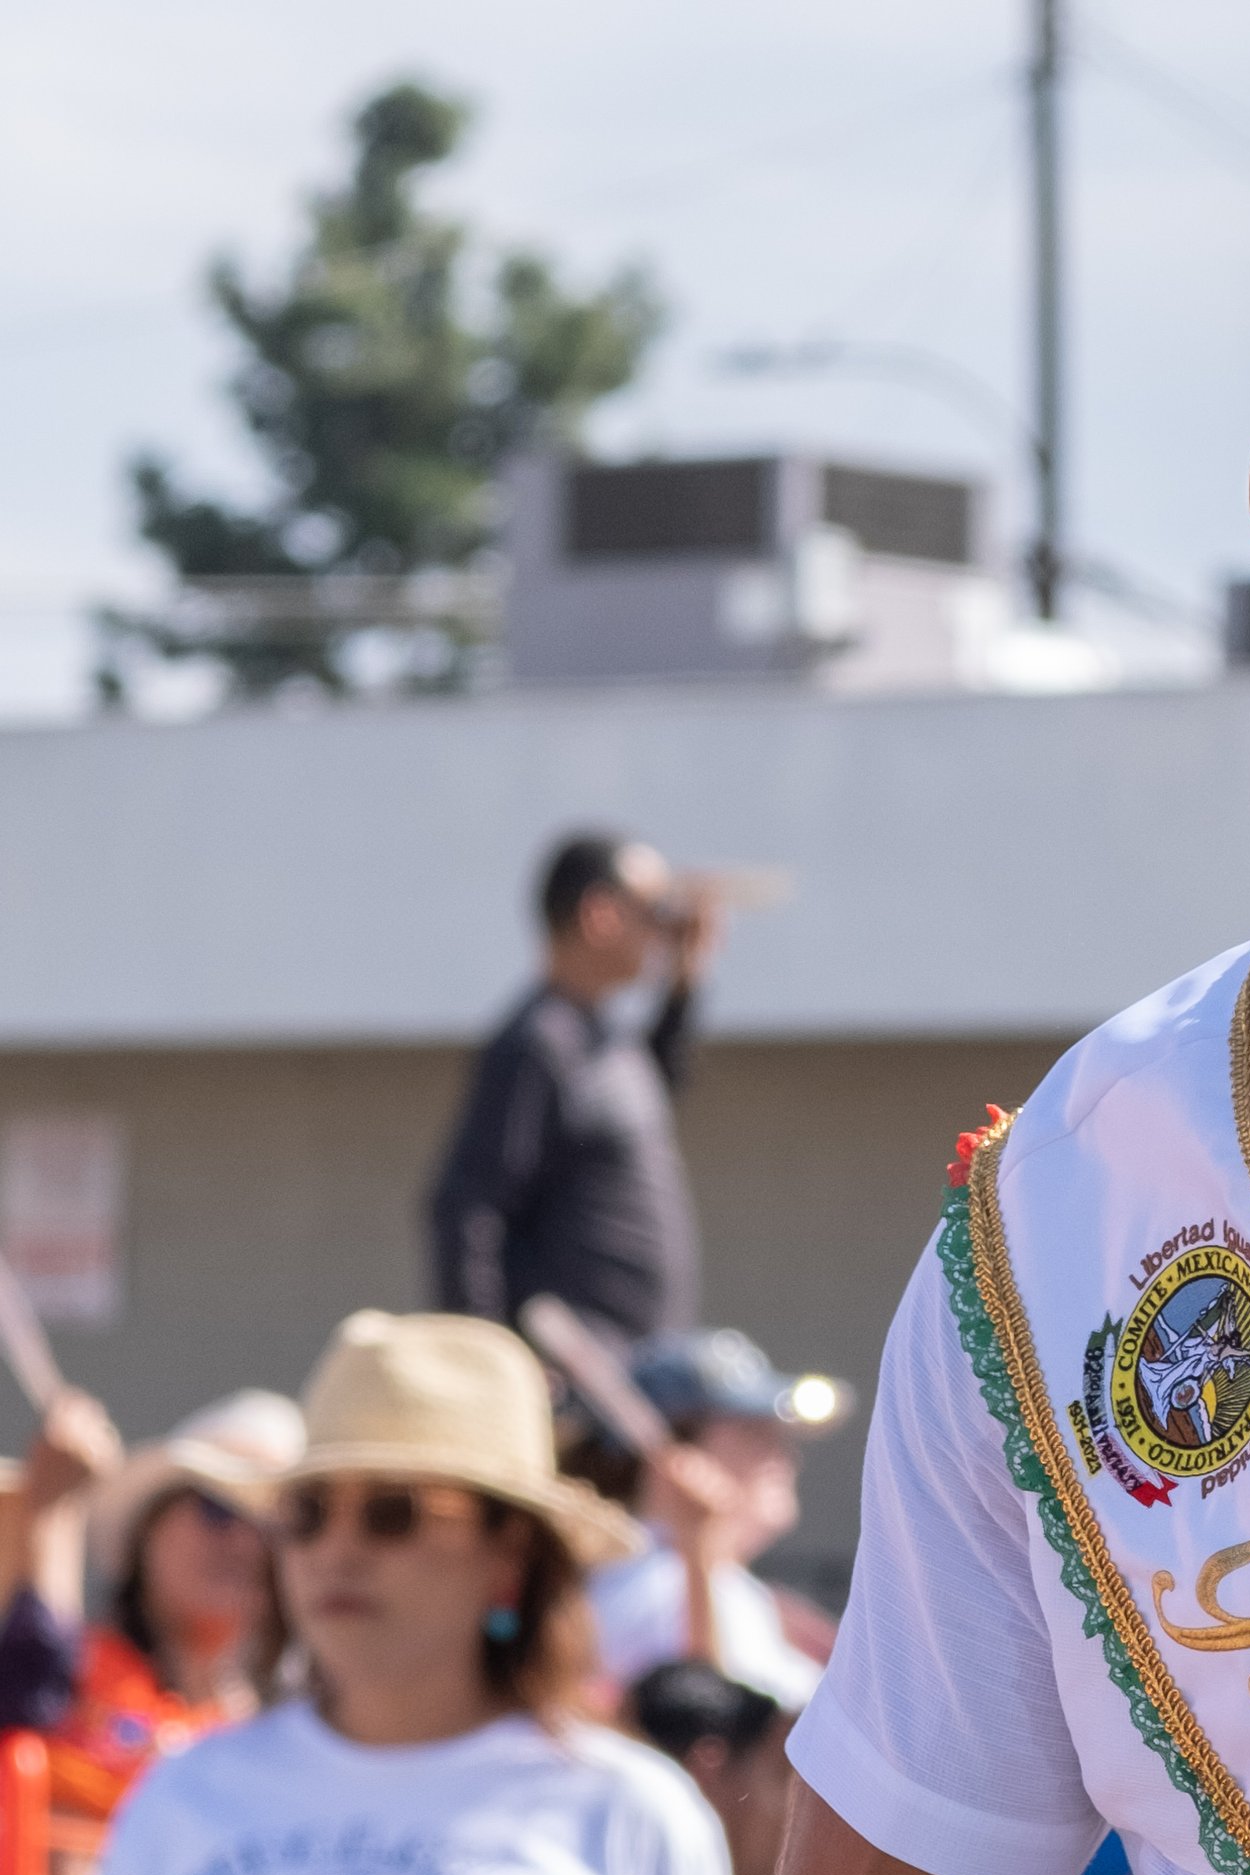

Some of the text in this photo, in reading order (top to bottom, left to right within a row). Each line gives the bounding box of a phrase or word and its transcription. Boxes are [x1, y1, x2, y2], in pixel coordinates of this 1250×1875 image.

[1128, 1217, 1215, 1291] Libertad
[1117, 1280, 1168, 1373] COMITE
[1067, 1399, 1103, 1476] 1931-2023
[1115, 1395, 1142, 1439] 1931
